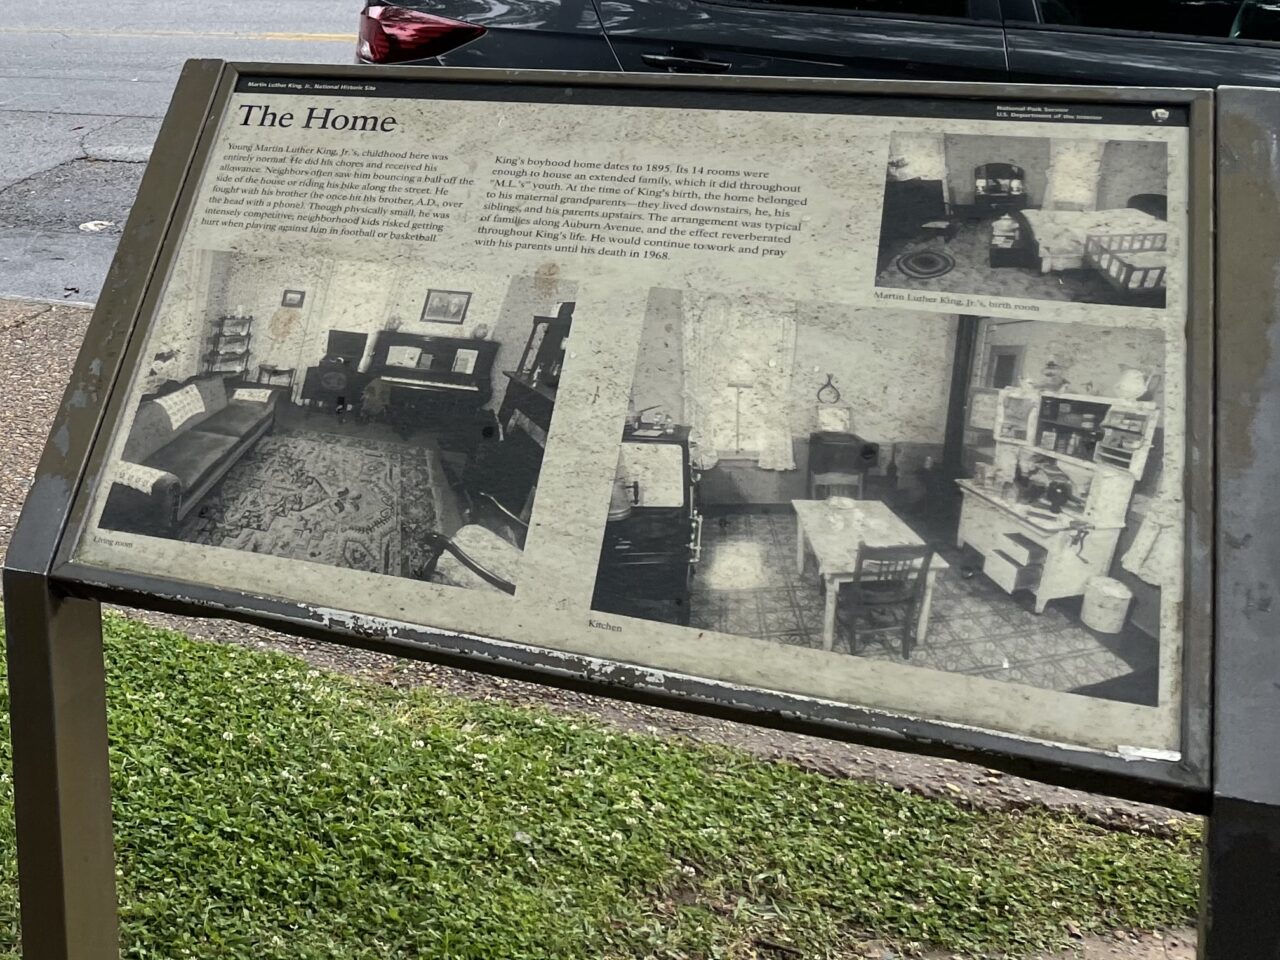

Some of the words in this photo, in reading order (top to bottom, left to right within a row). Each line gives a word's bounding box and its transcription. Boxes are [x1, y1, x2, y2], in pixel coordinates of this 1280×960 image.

[239, 105, 294, 128] The
[302, 108, 398, 132] Home
[495, 156, 525, 167] King's
[527, 158, 570, 168] boyhood
[573, 161, 601, 169] home
[604, 162, 629, 170] dates
[646, 164, 672, 173] 1895.
[676, 166, 688, 174] Its
[492, 169, 527, 179] enough
[543, 171, 571, 179] house
[589, 174, 635, 183] extended
[639, 176, 671, 187] family,
[675, 178, 706, 187] which
[740, 182, 801, 193] throughout
[499, 191, 512, 199] his
[515, 194, 558, 202] maternal
[663, 202, 687, 210] lived
[690, 204, 751, 216] downstairs,
[755, 208, 771, 217] he,
[775, 209, 790, 217] his
[533, 183, 563, 191] youth.
[599, 186, 620, 194] time
[638, 188, 669, 199] King's
[672, 190, 701, 200] birth,
[724, 193, 754, 202] home
[757, 195, 807, 207] belonged
[484, 202, 522, 213] siblings,
[546, 206, 559, 214] his
[602, 212, 643, 220] upstairs.
[648, 213, 668, 221] The
[671, 217, 738, 227] arrangement
[765, 222, 802, 232] typical
[494, 215, 530, 224] families
[533, 218, 560, 229] along
[562, 220, 600, 229] Auburn
[603, 223, 643, 233] Avenue,
[689, 229, 718, 238] effect
[722, 233, 791, 243] reverberated
[478, 226, 532, 237] throughout
[535, 230, 567, 241] King's
[570, 233, 585, 241] life.
[591, 234, 605, 242] He
[609, 237, 640, 245] would
[644, 240, 691, 249] continue
[762, 249, 787, 258] pray
[499, 239, 513, 247] his
[581, 246, 595, 254] his
[598, 247, 626, 256] death
[643, 251, 670, 260] 1968.
[874, 292, 904, 300] Martin
[907, 293, 937, 303] Luther
[940, 296, 964, 306] King,
[989, 301, 1012, 309] birth
[93, 536, 114, 545] Living
[588, 619, 622, 632] Kitchen
